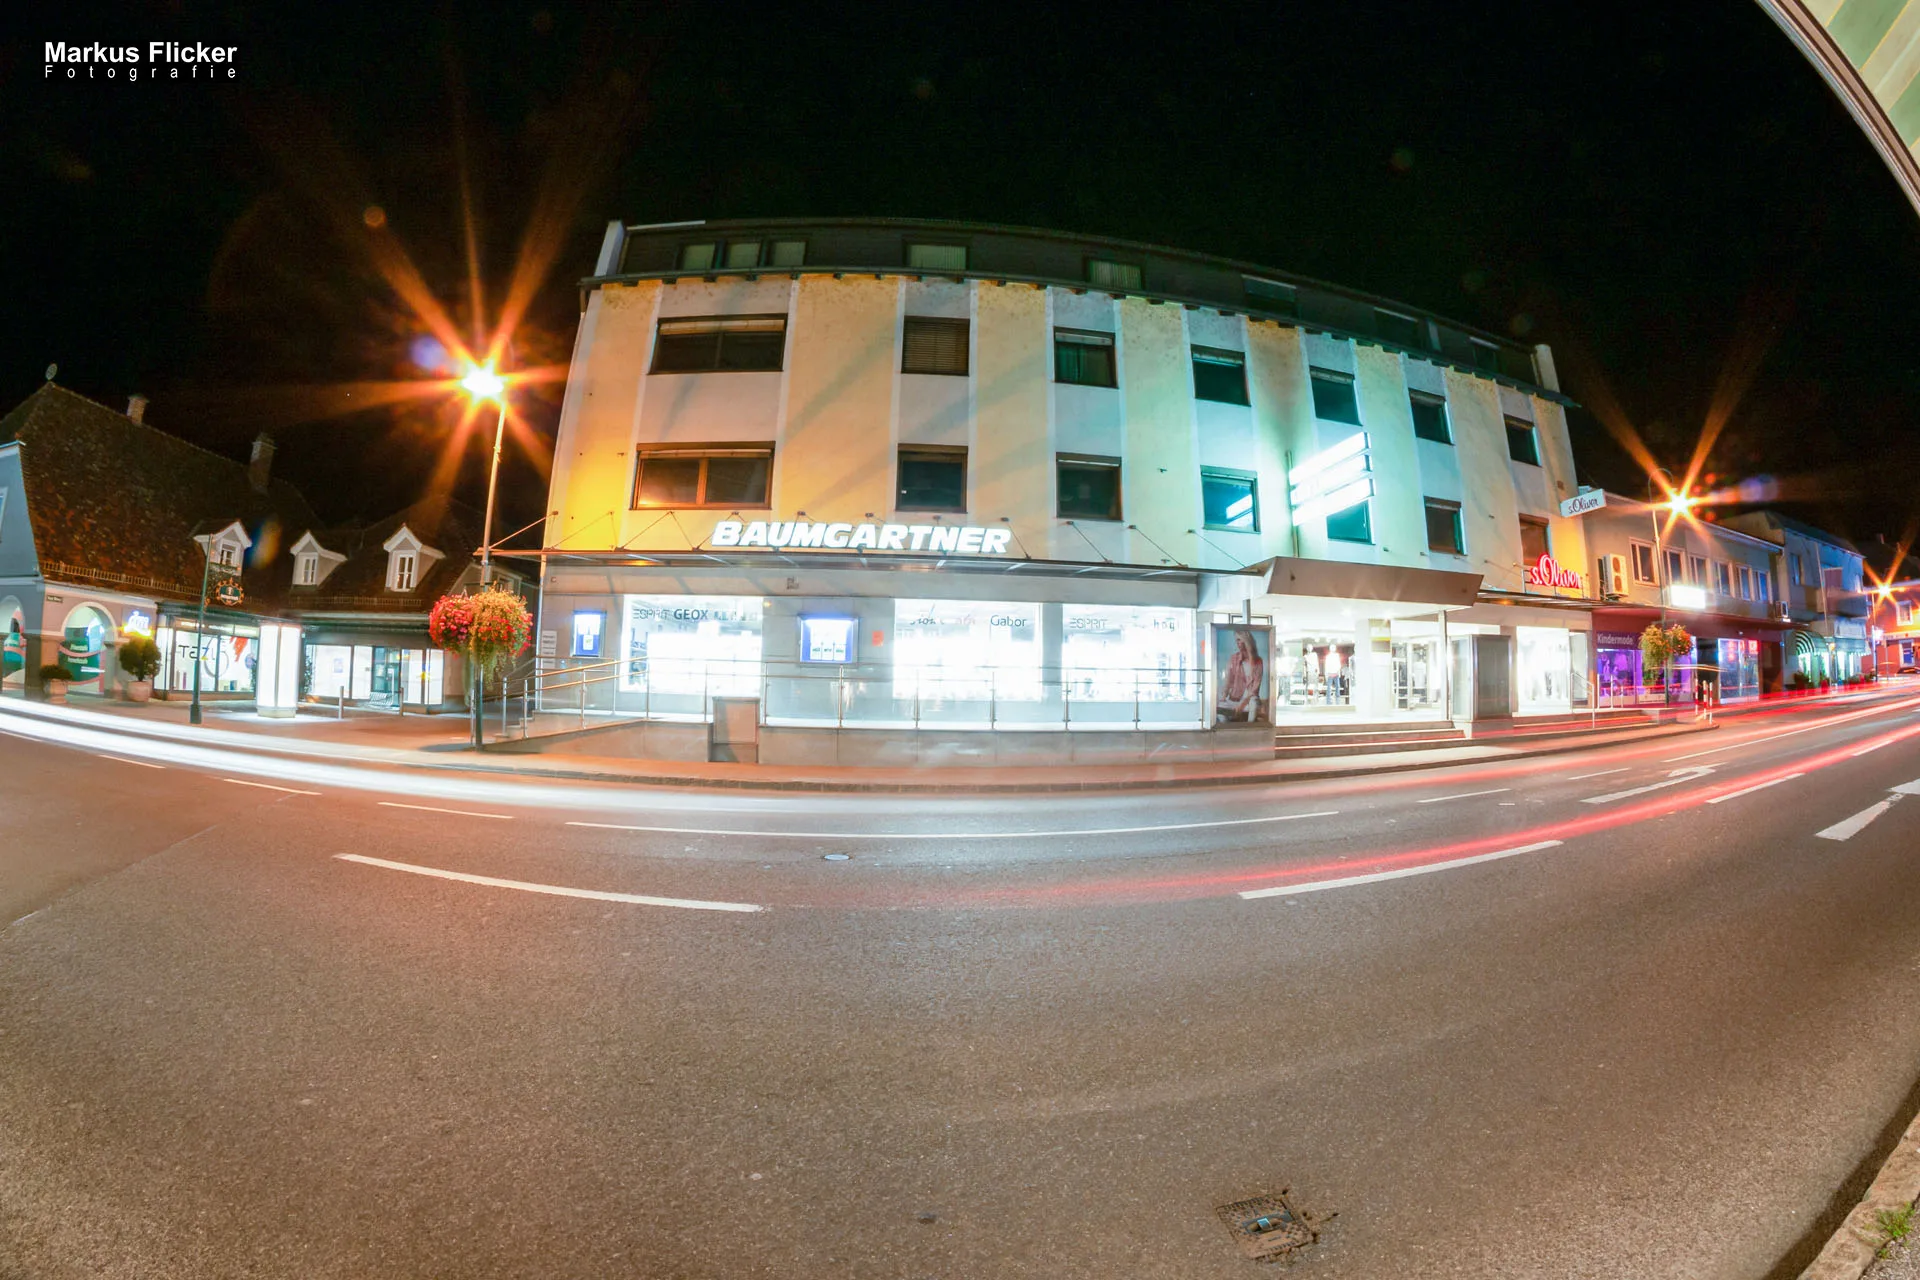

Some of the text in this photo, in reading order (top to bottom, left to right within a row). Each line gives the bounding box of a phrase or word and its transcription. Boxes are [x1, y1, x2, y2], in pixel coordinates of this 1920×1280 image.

[1568, 497, 1599, 514] s.Oliver
[711, 520, 1012, 554] BAUMGARTNER
[1530, 551, 1582, 589] s.Oliver
[632, 608, 670, 620] ESPRIT
[673, 608, 709, 620] GEOX
[990, 614, 1028, 628] Gabor
[1069, 617, 1108, 629] ESPRIT
